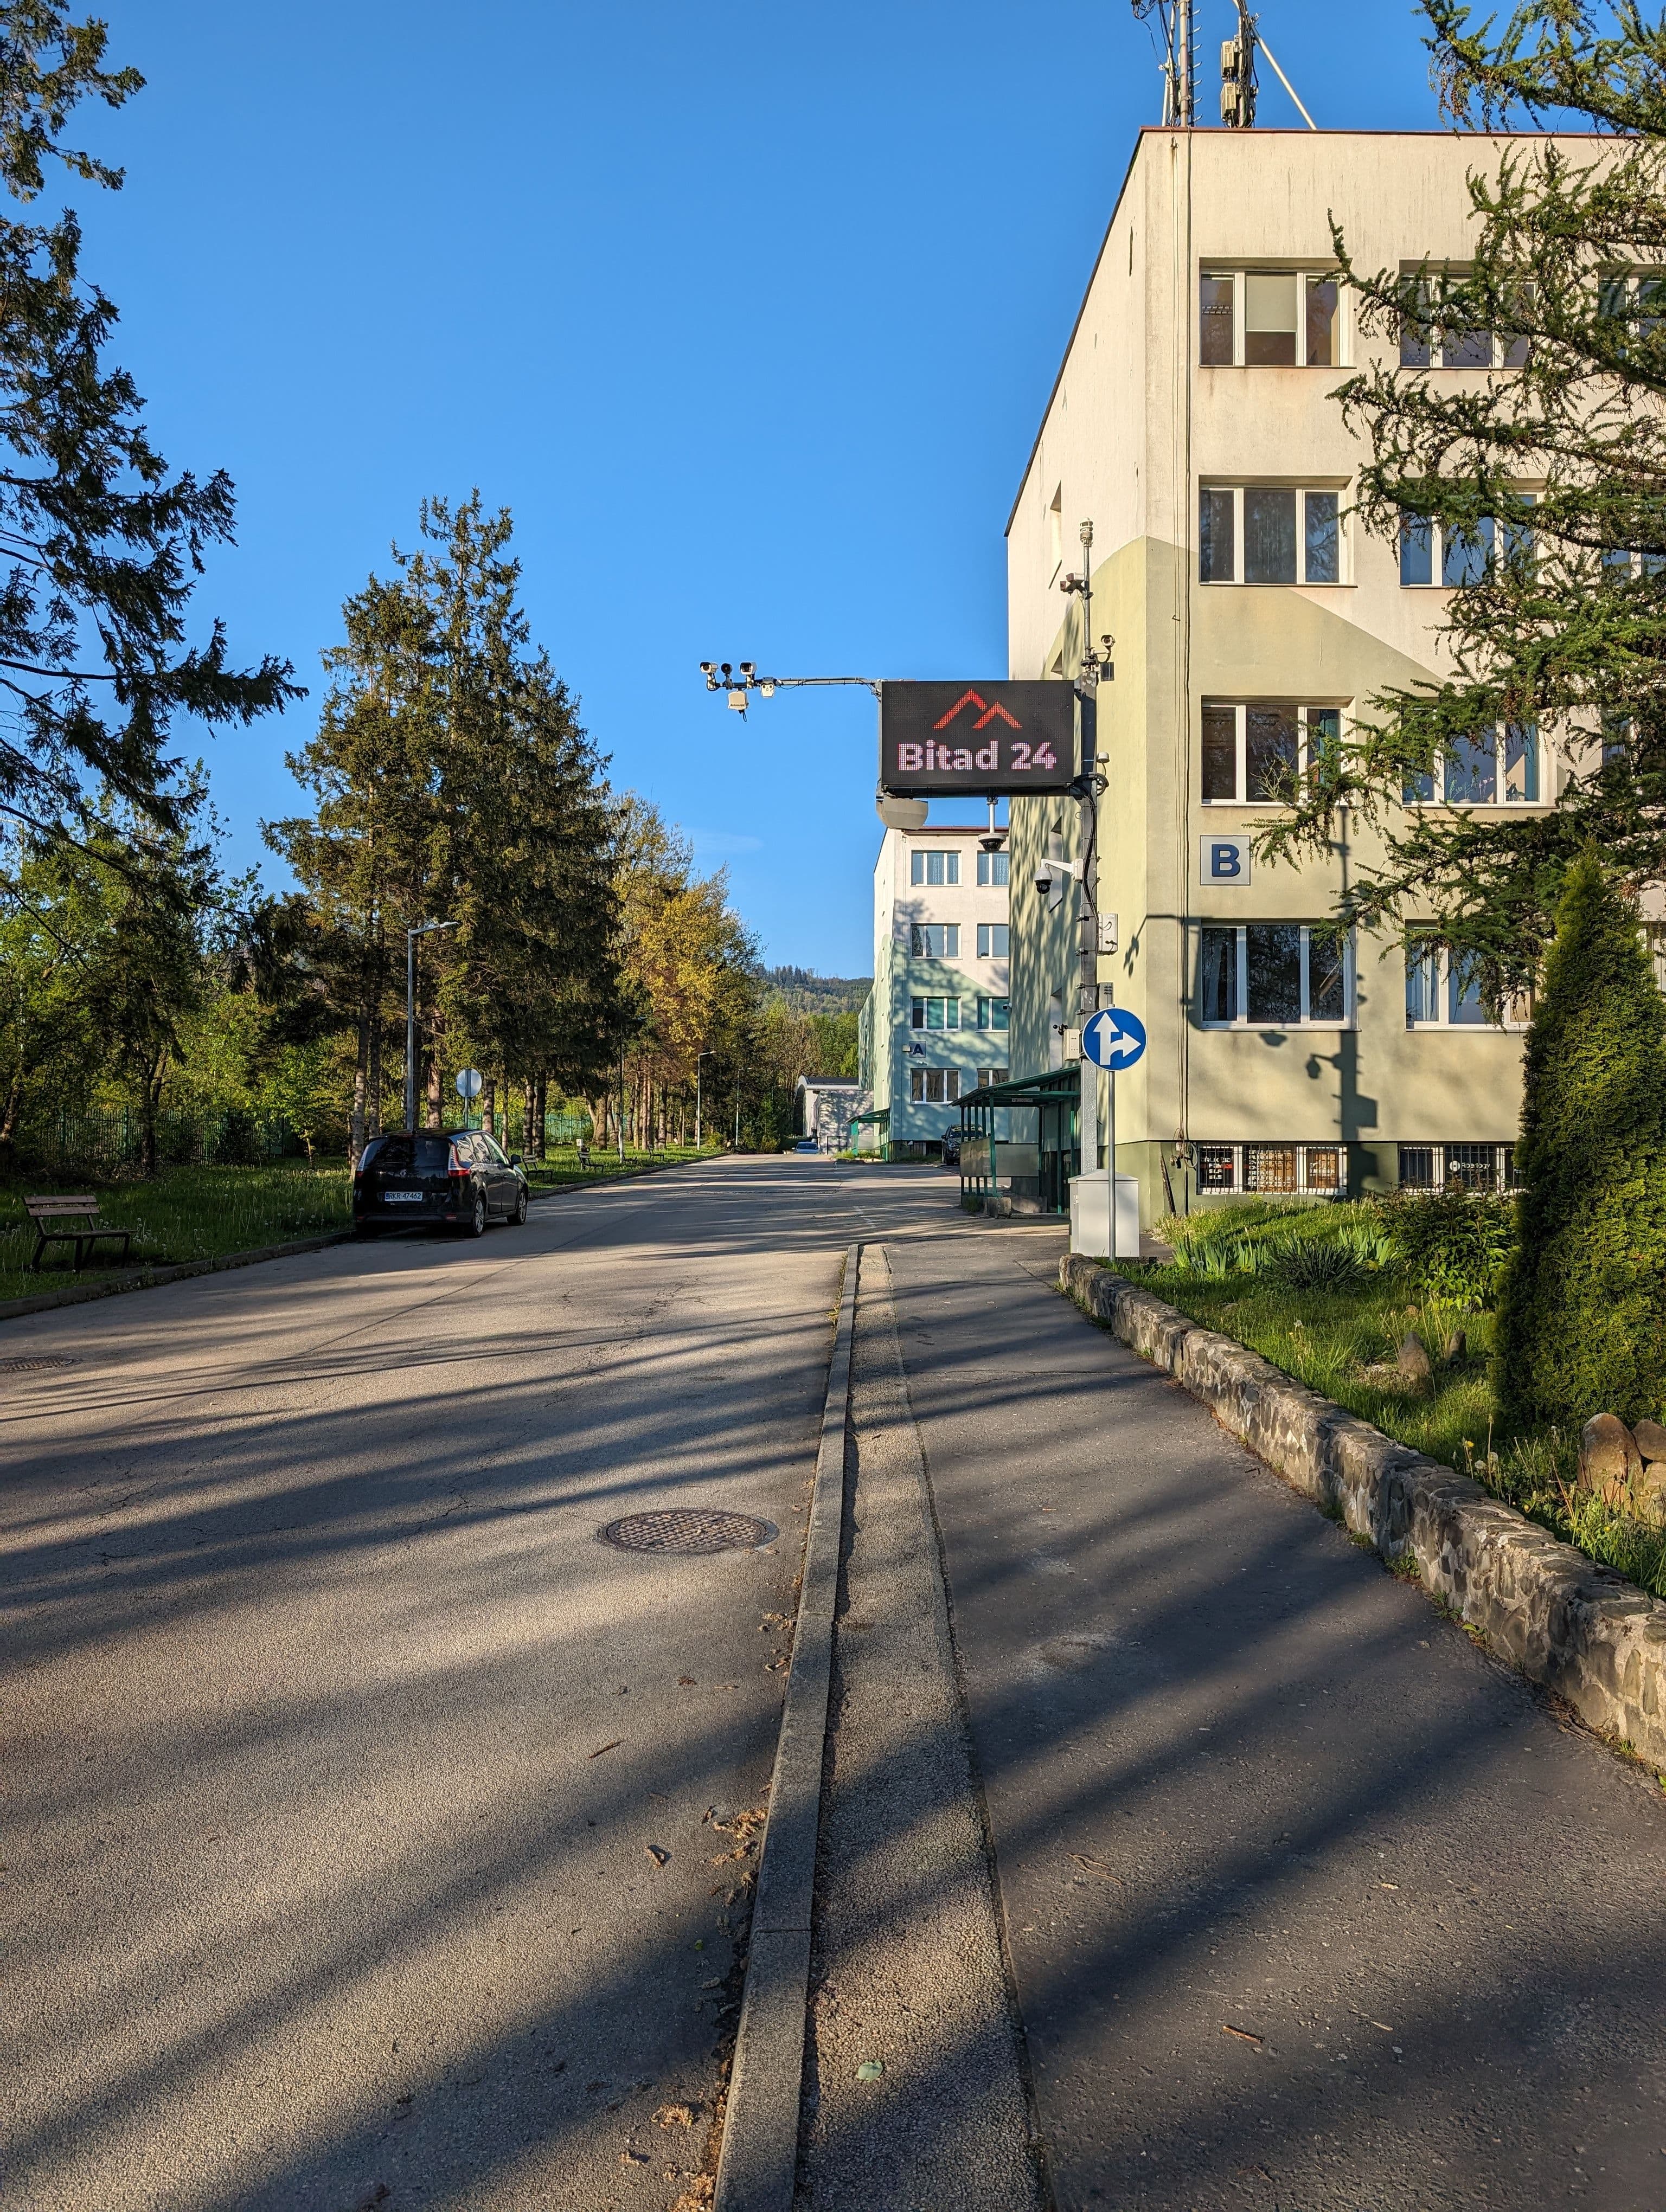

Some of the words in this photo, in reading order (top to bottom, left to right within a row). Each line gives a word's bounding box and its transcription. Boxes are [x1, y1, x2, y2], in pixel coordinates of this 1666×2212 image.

[898, 739, 998, 770] Bitad
[1010, 742, 1057, 770] 24
[1211, 844, 1241, 877] B
[912, 1044, 924, 1055] A
